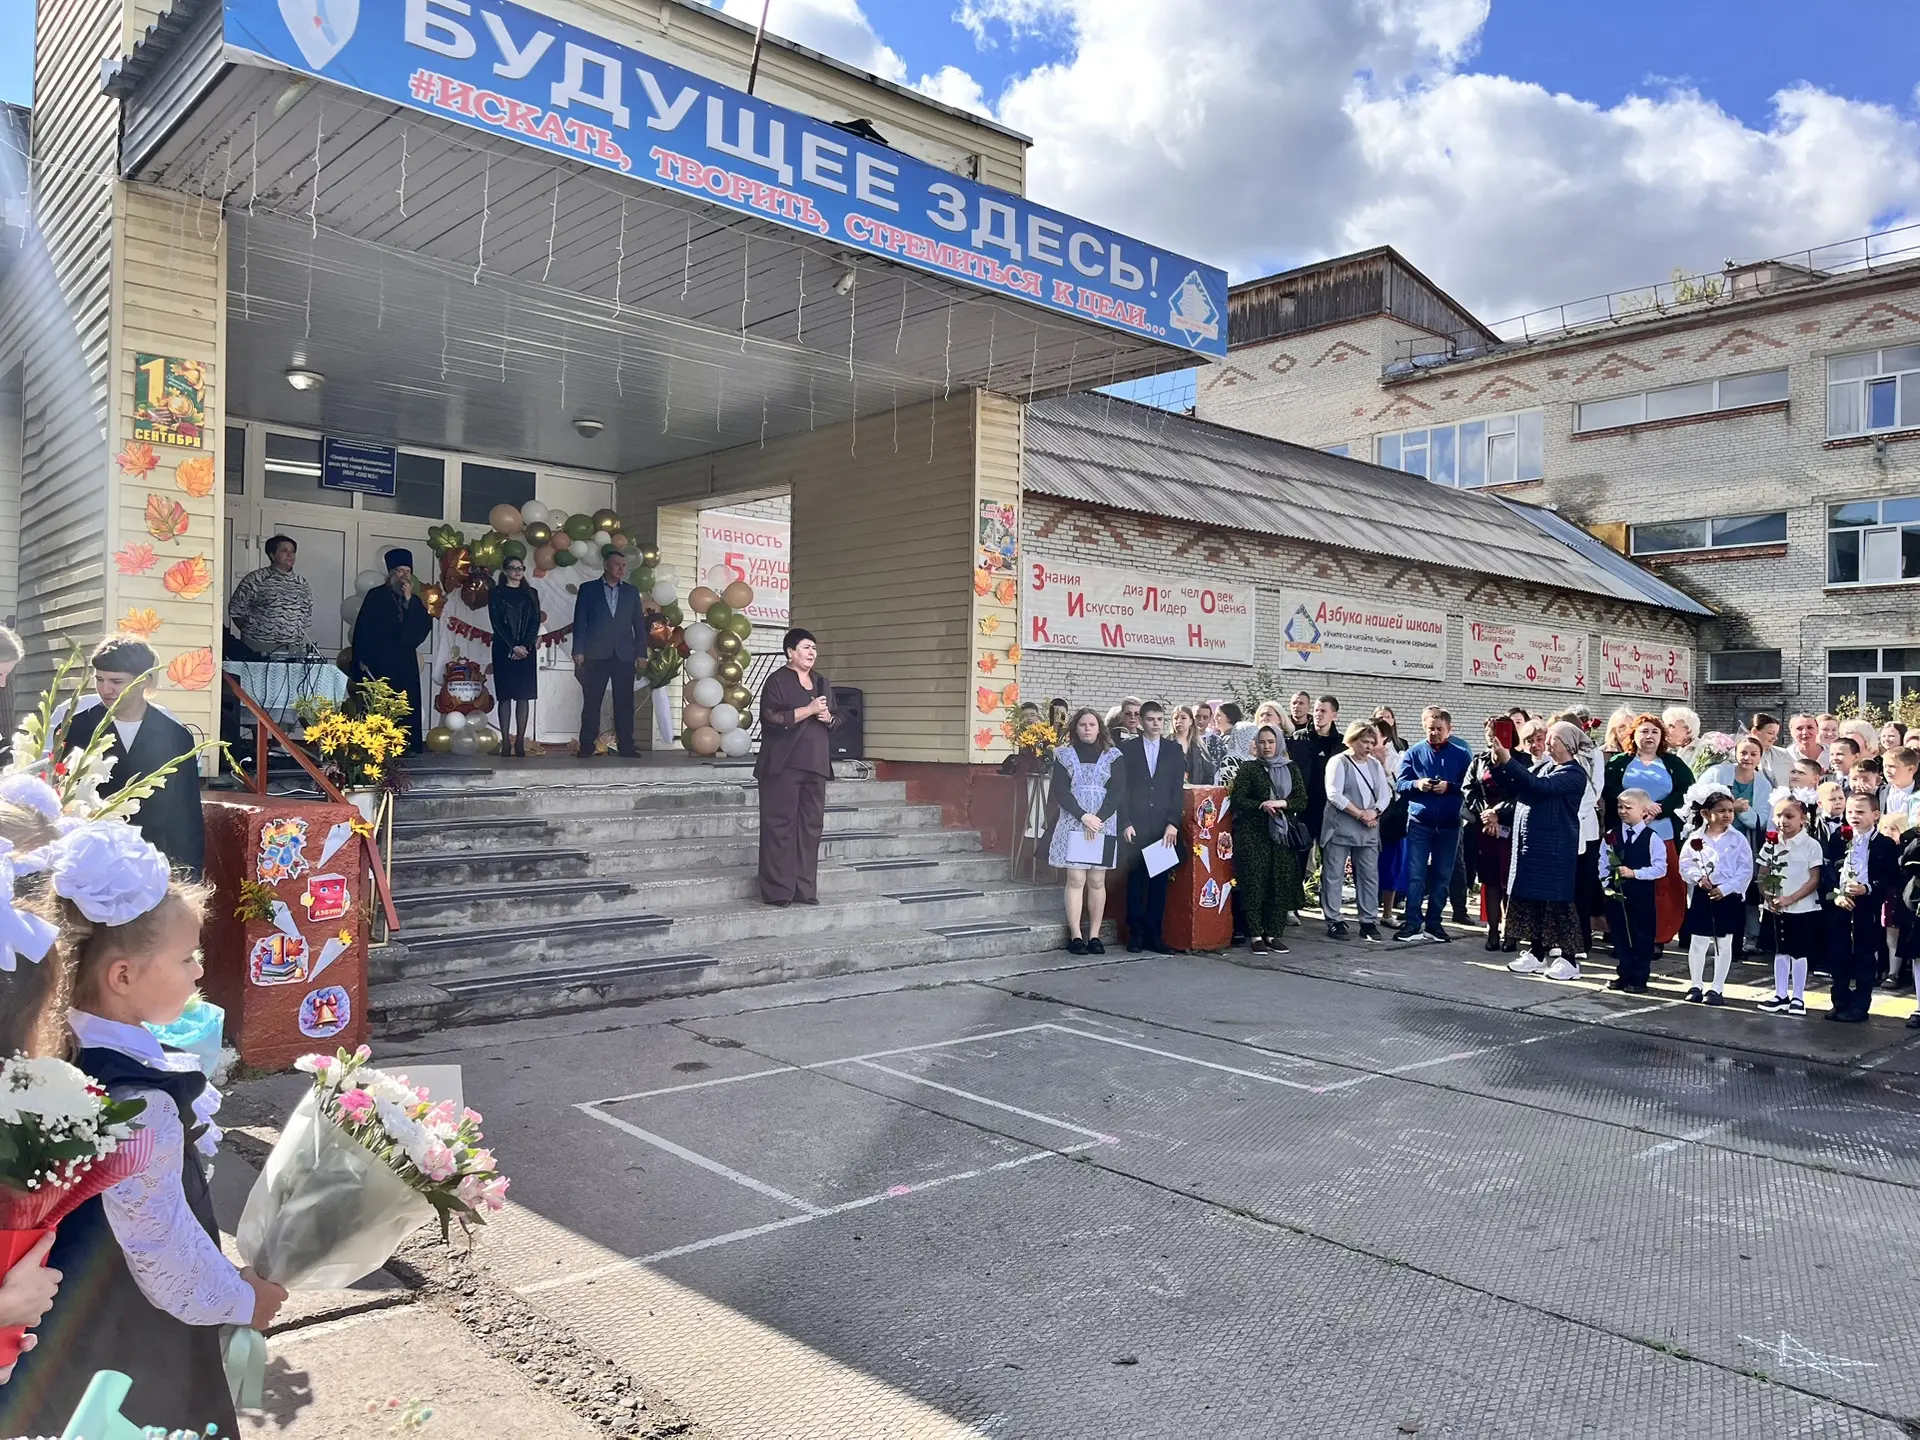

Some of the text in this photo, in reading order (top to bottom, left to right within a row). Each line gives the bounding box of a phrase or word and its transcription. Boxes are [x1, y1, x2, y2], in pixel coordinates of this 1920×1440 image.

[403, 0, 1159, 299] БУДУЩЕЕ ЗДЕСЬ!
[408, 67, 632, 171] #ИСКАТЬ,
[648, 145, 830, 235] ТВОРИТЬ,
[843, 212, 1042, 296] СТРЕМИТЬСЯ
[1052, 279, 1079, 306] К
[140, 358, 165, 408] 1
[135, 428, 201, 448] СЕНТЯБРЯ
[1032, 563, 1081, 591] Знания
[1067, 591, 1134, 618] Искусство
[1314, 601, 1443, 634] Азбука нашей школы
[1032, 615, 1226, 649] Класс Мотивация Науки
[269, 935, 285, 966] 1
